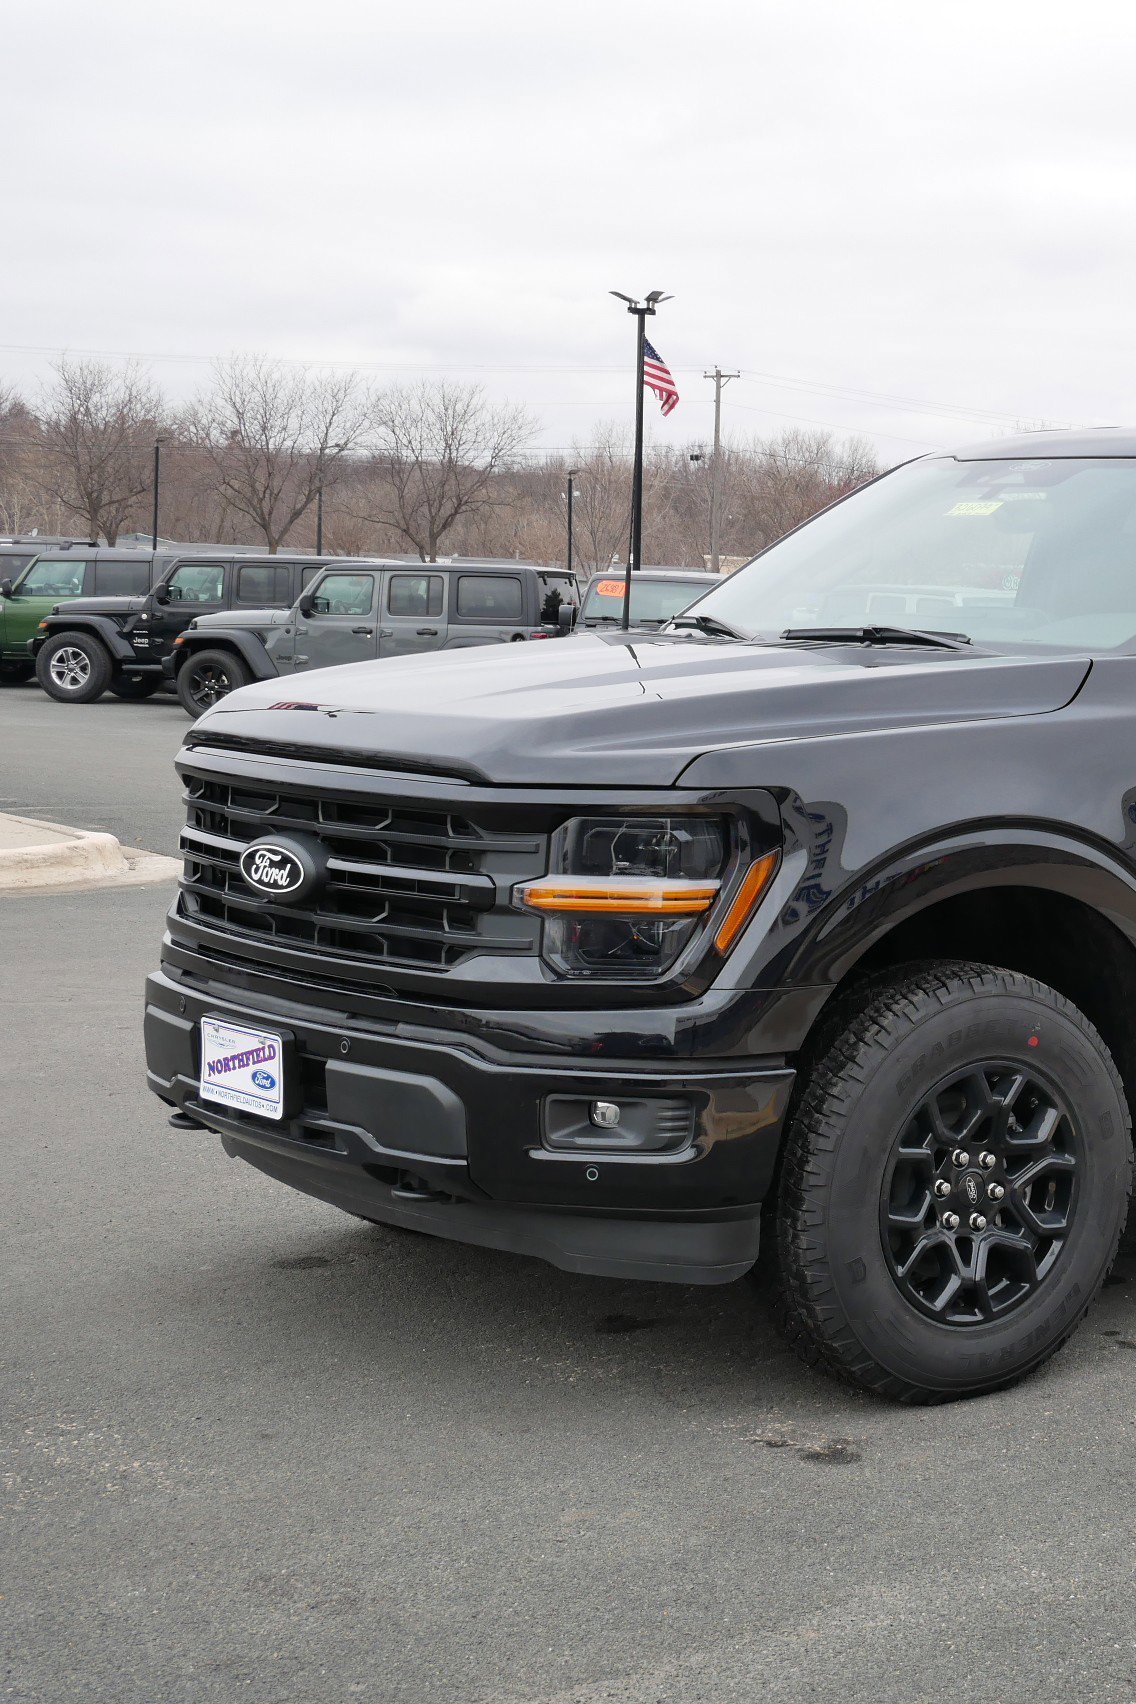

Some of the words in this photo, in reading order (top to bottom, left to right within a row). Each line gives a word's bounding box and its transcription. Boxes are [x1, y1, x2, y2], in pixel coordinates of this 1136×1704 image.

[251, 850, 292, 887] Ford
[206, 1043, 277, 1078] NORTHFIELD
[254, 1070, 272, 1089] Ford
